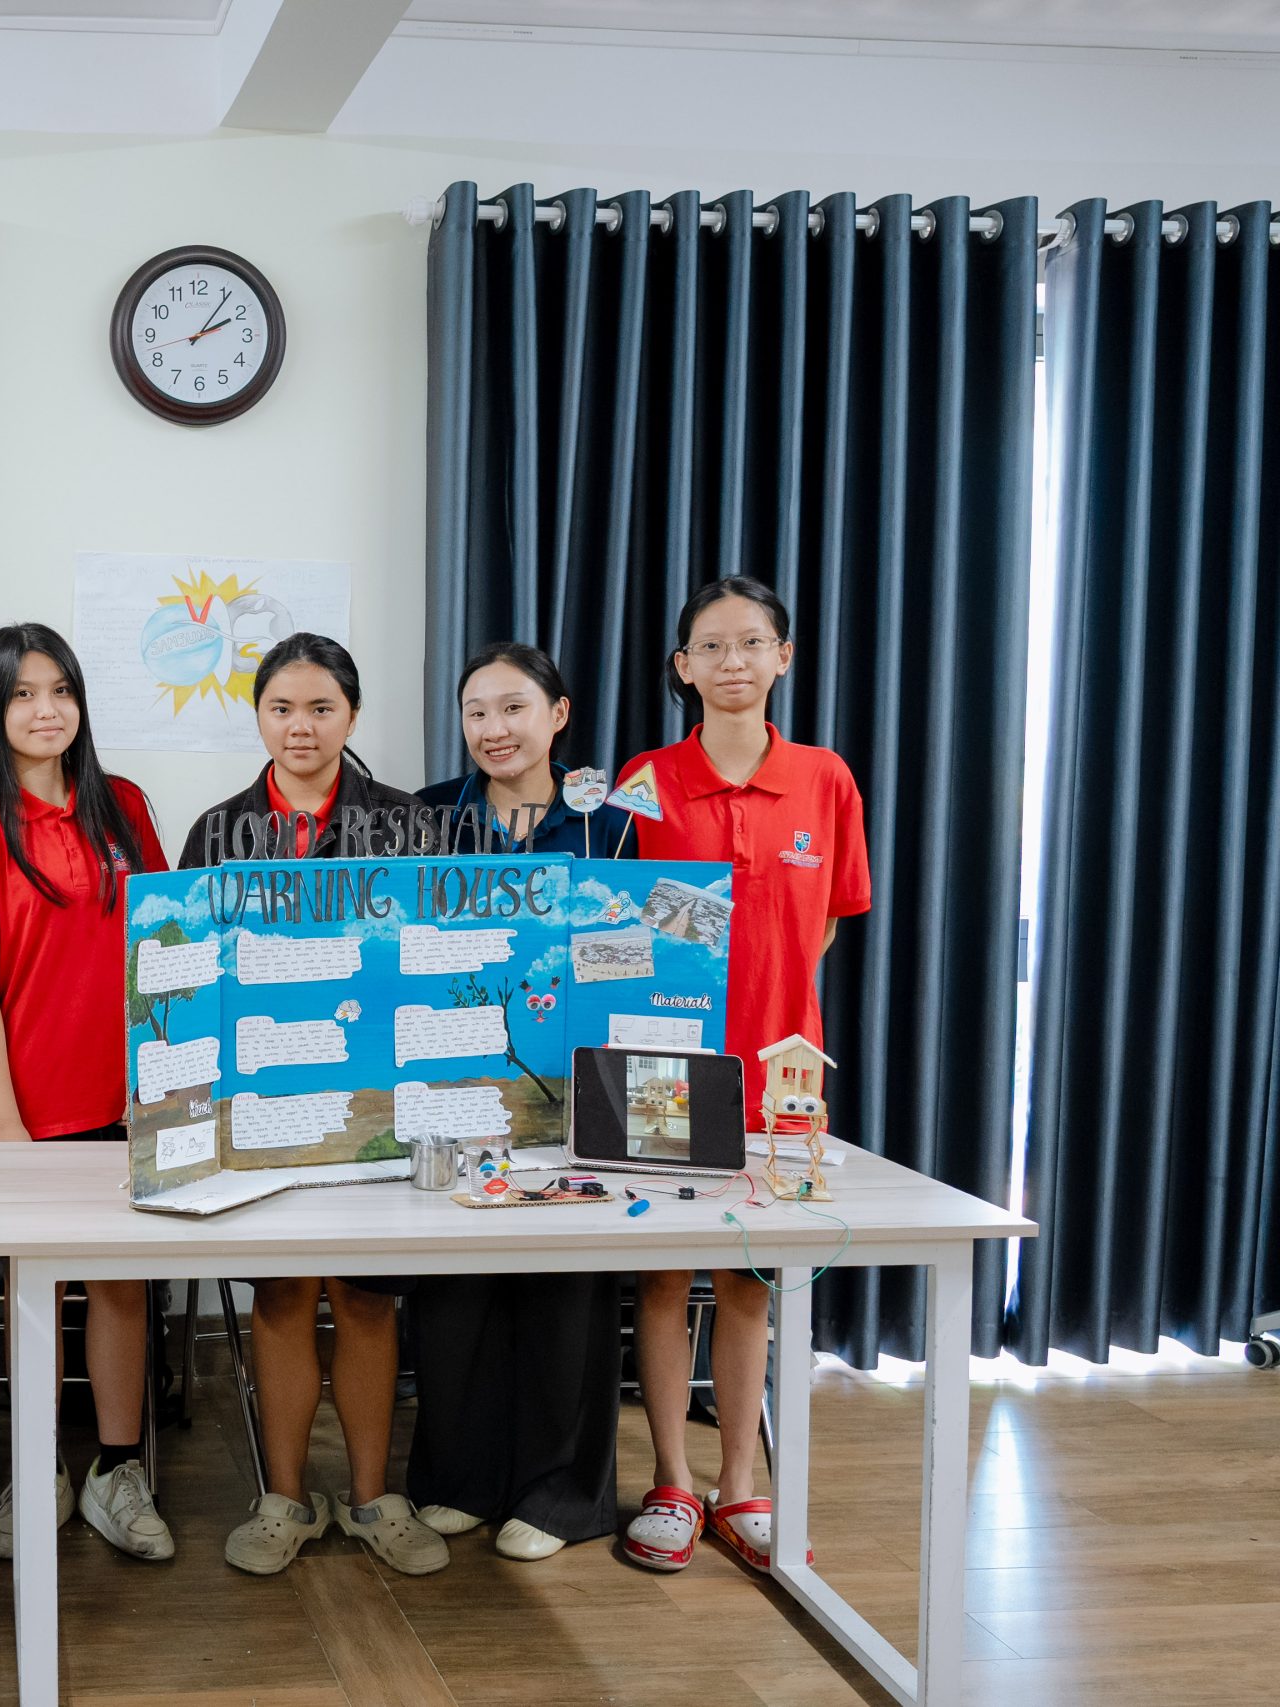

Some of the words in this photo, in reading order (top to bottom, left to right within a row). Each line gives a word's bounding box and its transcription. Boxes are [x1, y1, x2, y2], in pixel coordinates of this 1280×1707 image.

[169, 287, 182, 301] 11
[189, 280, 208, 295] 12
[152, 305, 169, 319] 10
[236, 305, 246, 320] 2
[145, 328, 156, 343] 9
[242, 328, 253, 343] 3
[152, 352, 163, 367] 8
[233, 352, 245, 367] 4
[171, 370, 182, 384] 7
[194, 376, 205, 391] 6
[218, 370, 228, 384] 5
[185, 594, 213, 624] V
[341, 803, 548, 857] RESISTANT
[208, 867, 392, 925] WARNING
[417, 865, 552, 920] HOUSE
[650, 992, 712, 1010] Materials
